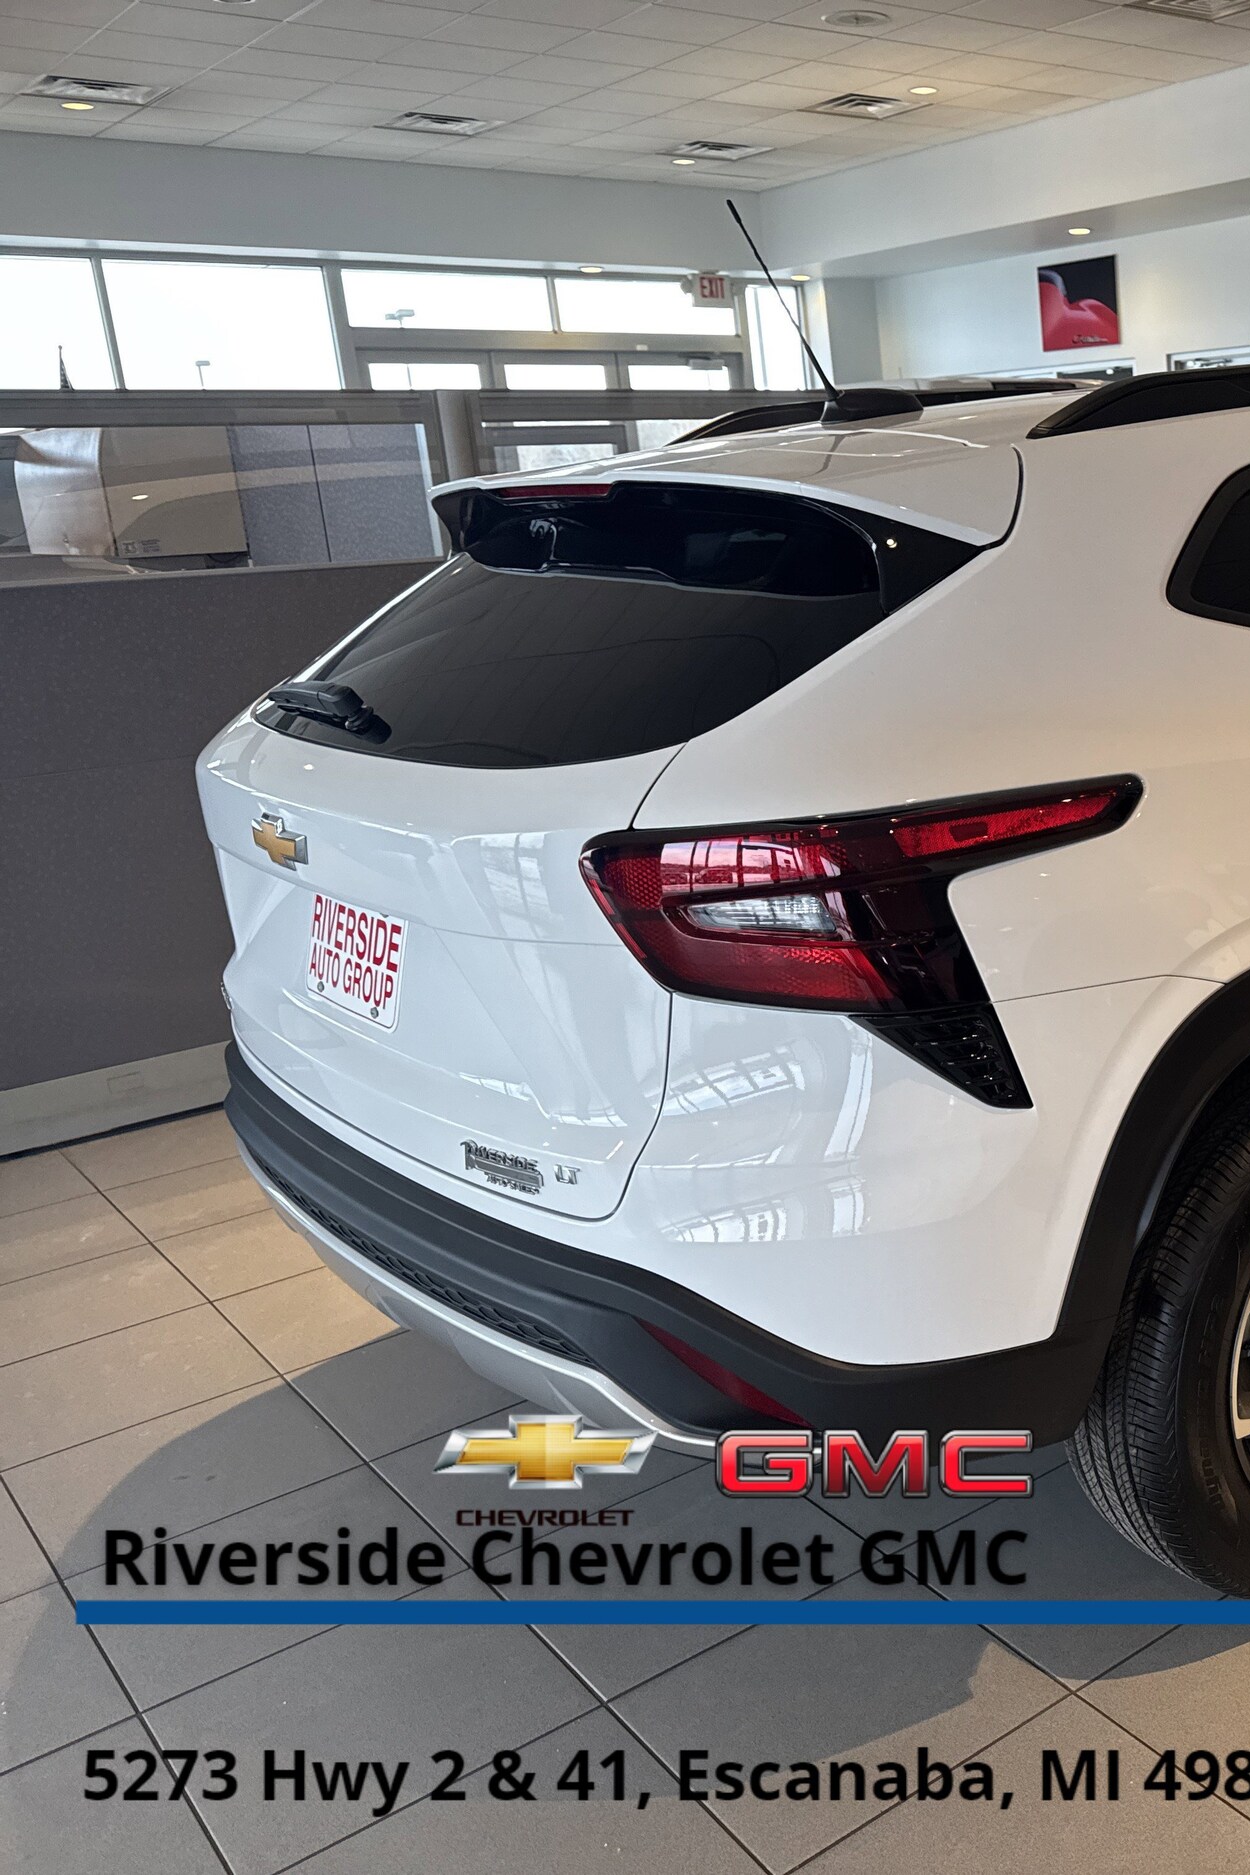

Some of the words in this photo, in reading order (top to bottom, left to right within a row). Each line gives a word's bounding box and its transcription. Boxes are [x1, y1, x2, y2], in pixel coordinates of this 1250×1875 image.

[699, 276, 725, 299] EXIT
[312, 894, 402, 973] RIVERSIDE
[310, 943, 341, 988] AUTO
[342, 957, 394, 1010] GROUP
[553, 1164, 581, 1184] LT
